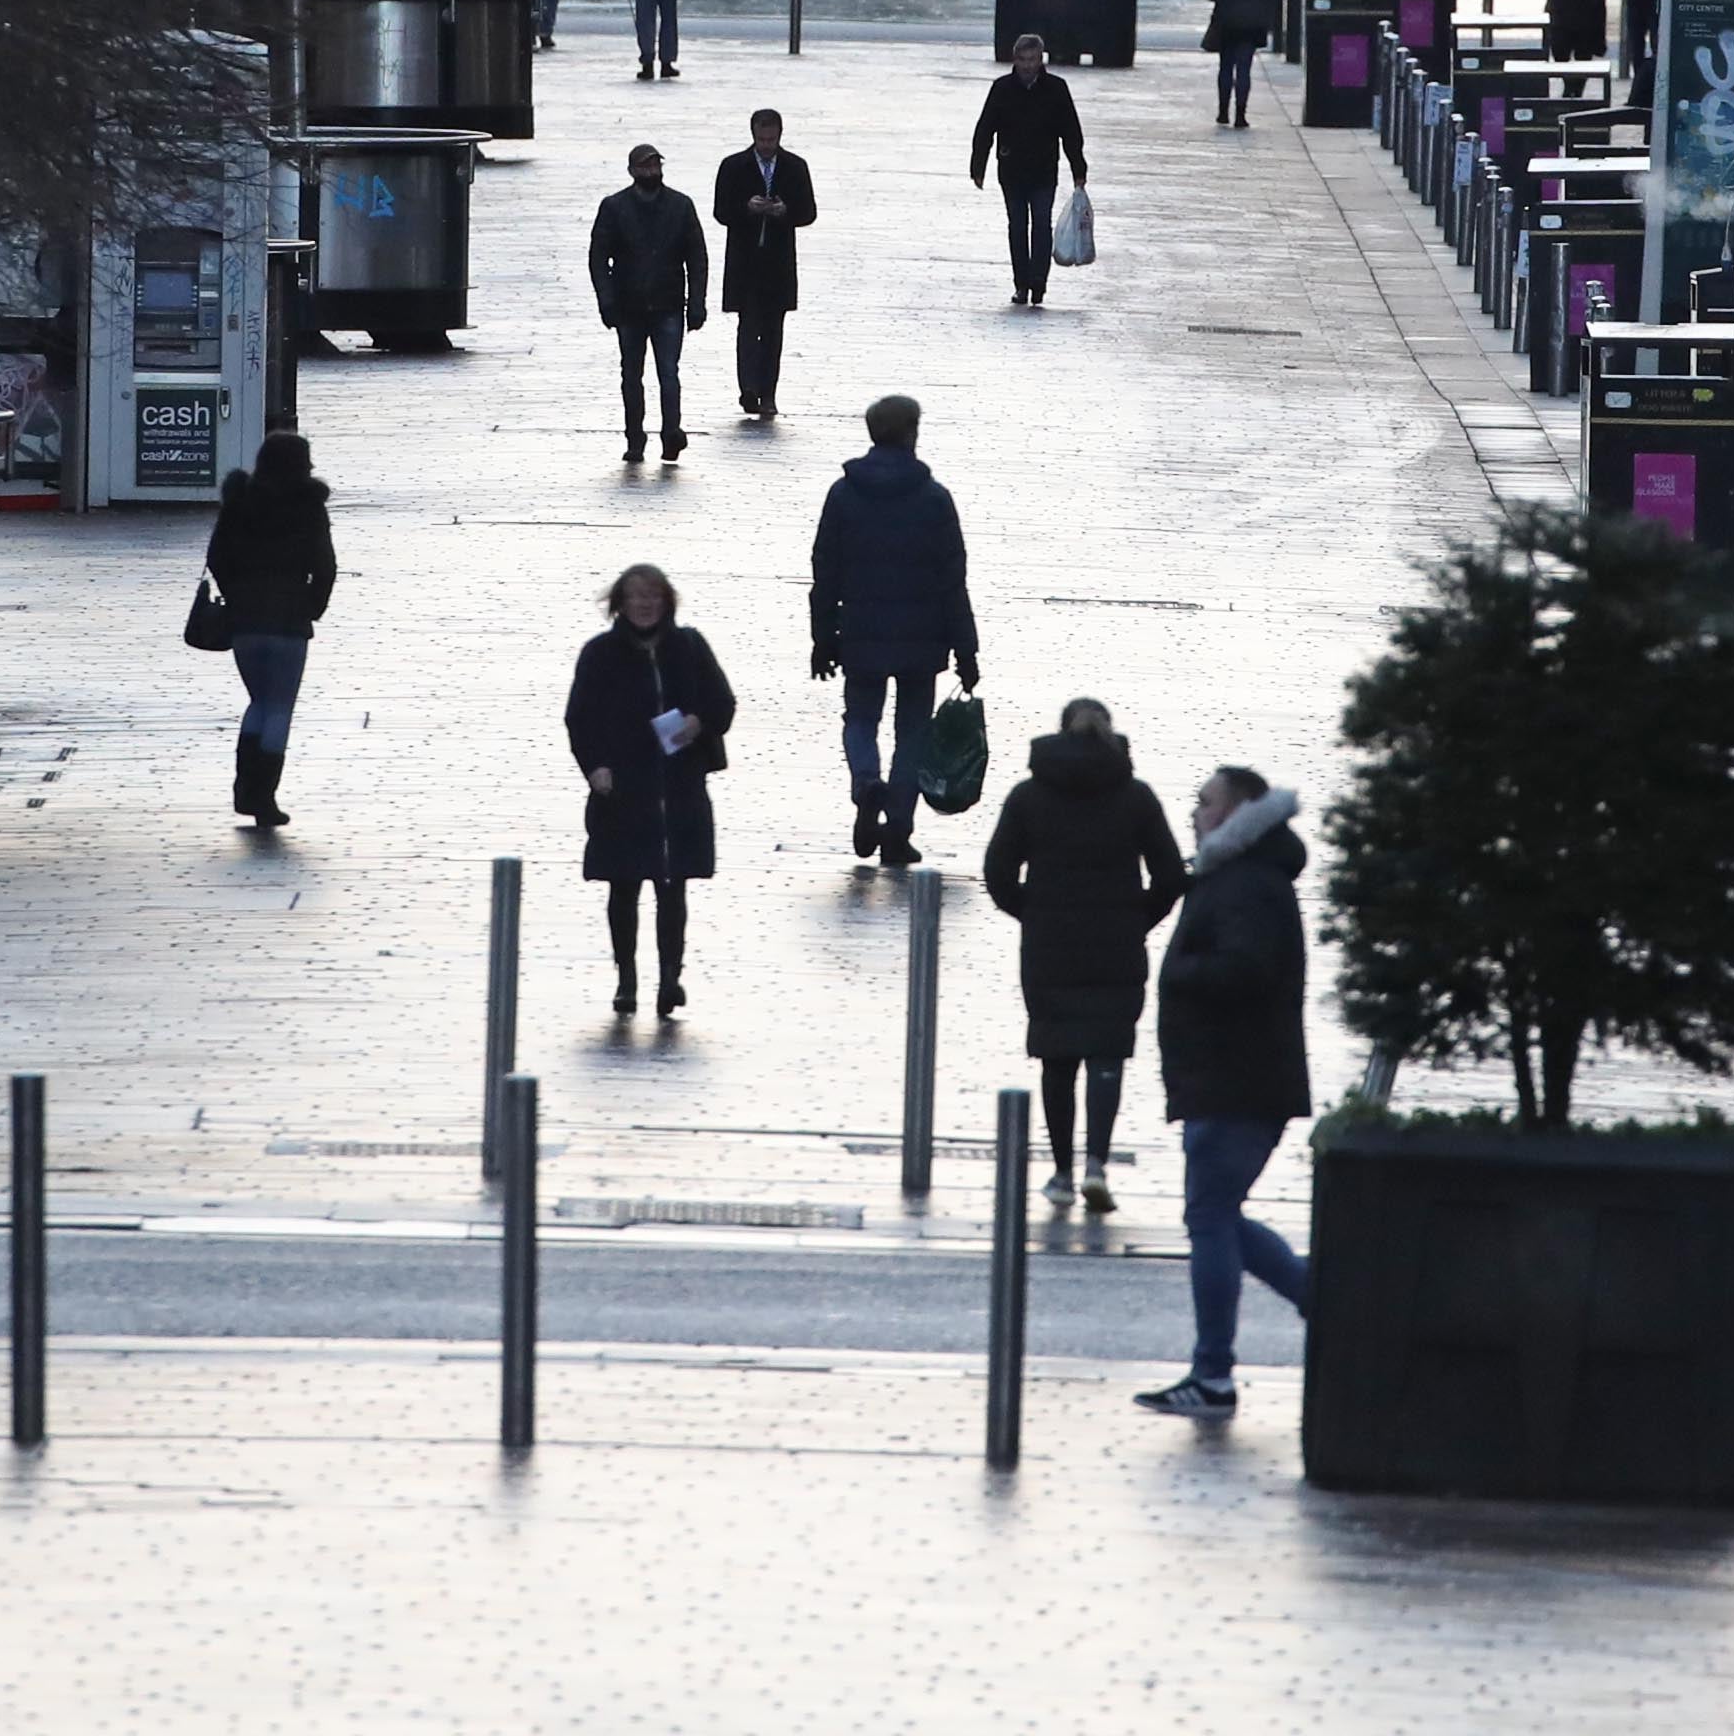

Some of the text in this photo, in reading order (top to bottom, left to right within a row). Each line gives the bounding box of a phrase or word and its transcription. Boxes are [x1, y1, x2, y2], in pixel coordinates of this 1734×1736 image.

[142, 400, 210, 425] cash
[143, 429, 210, 437] withdrawals and
